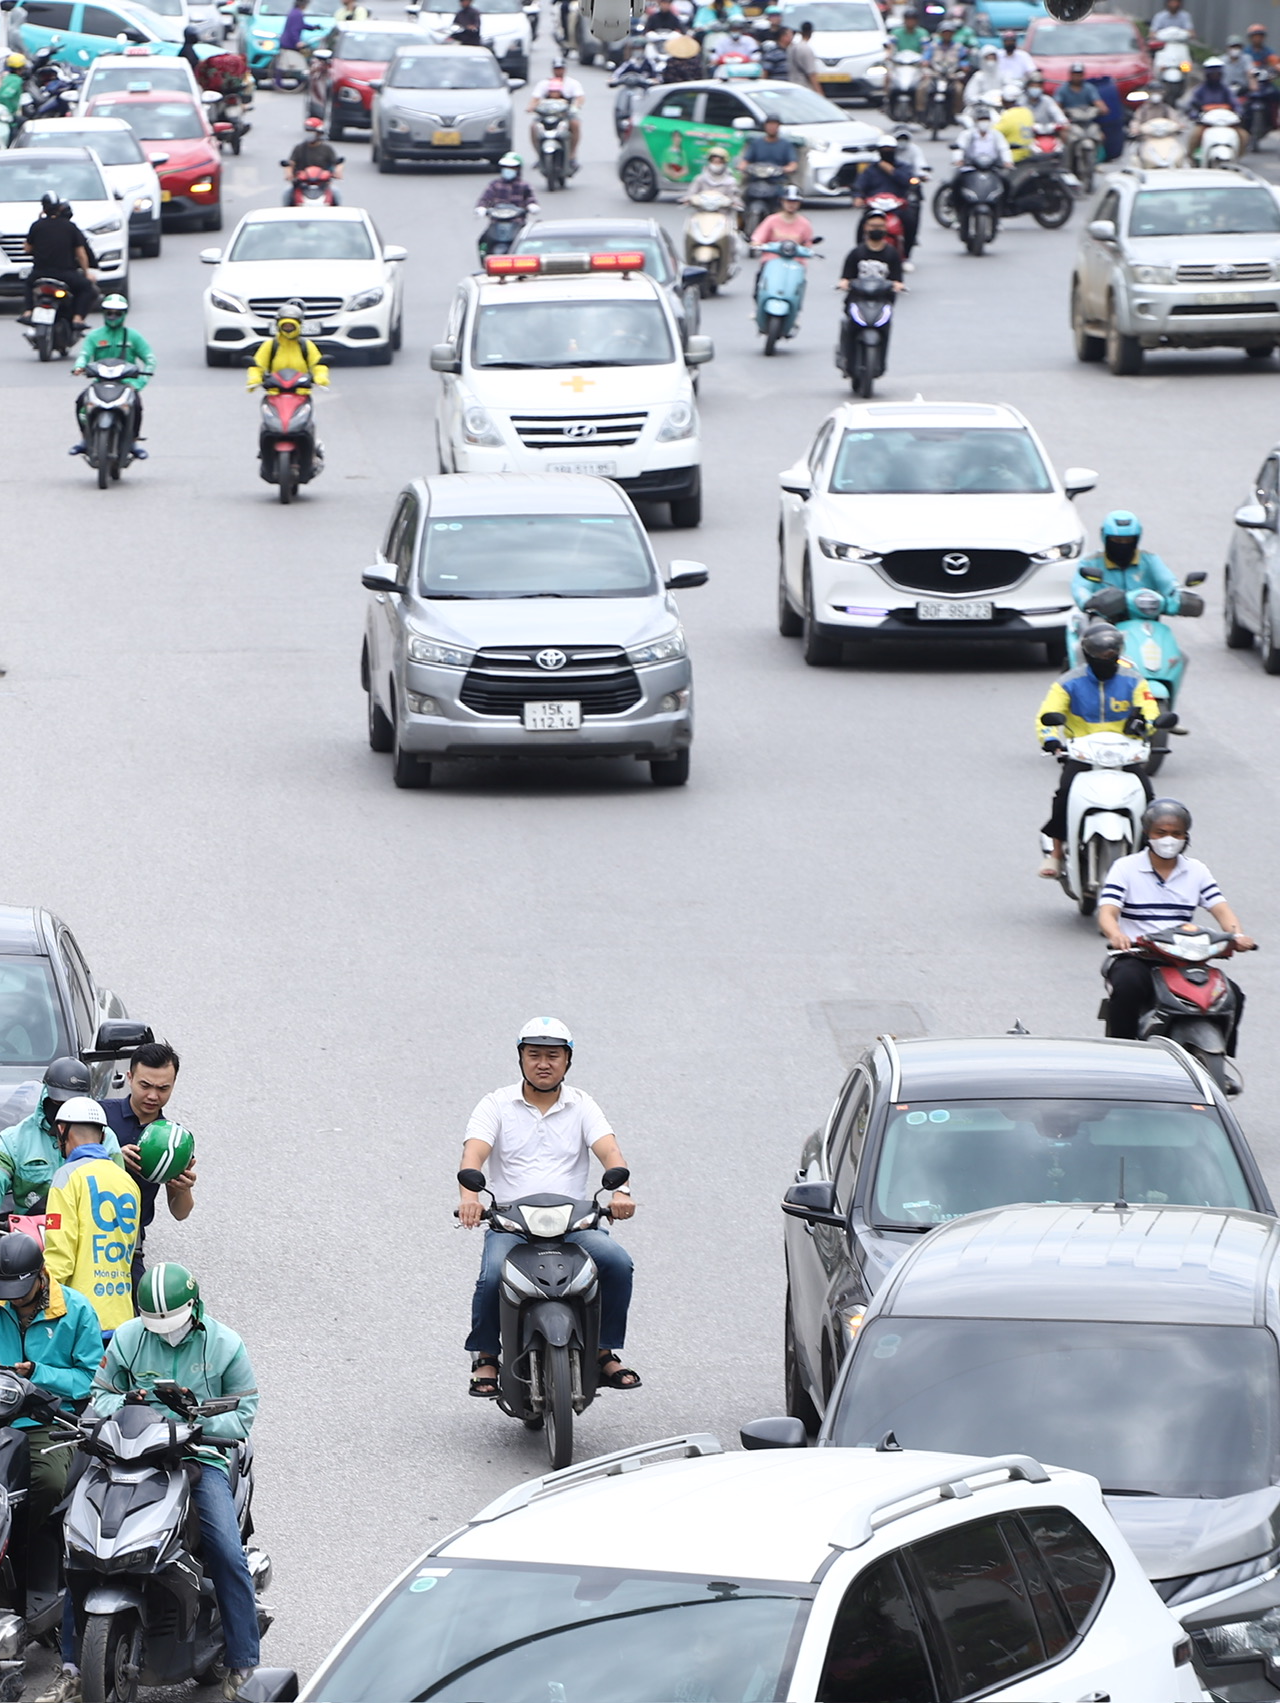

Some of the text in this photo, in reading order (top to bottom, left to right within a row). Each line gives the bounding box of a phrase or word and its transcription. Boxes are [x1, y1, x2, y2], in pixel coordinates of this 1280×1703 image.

[542, 704, 564, 715] 15K
[1110, 696, 1131, 712] be
[532, 717, 574, 728] 112.14
[86, 1175, 136, 1234] be
